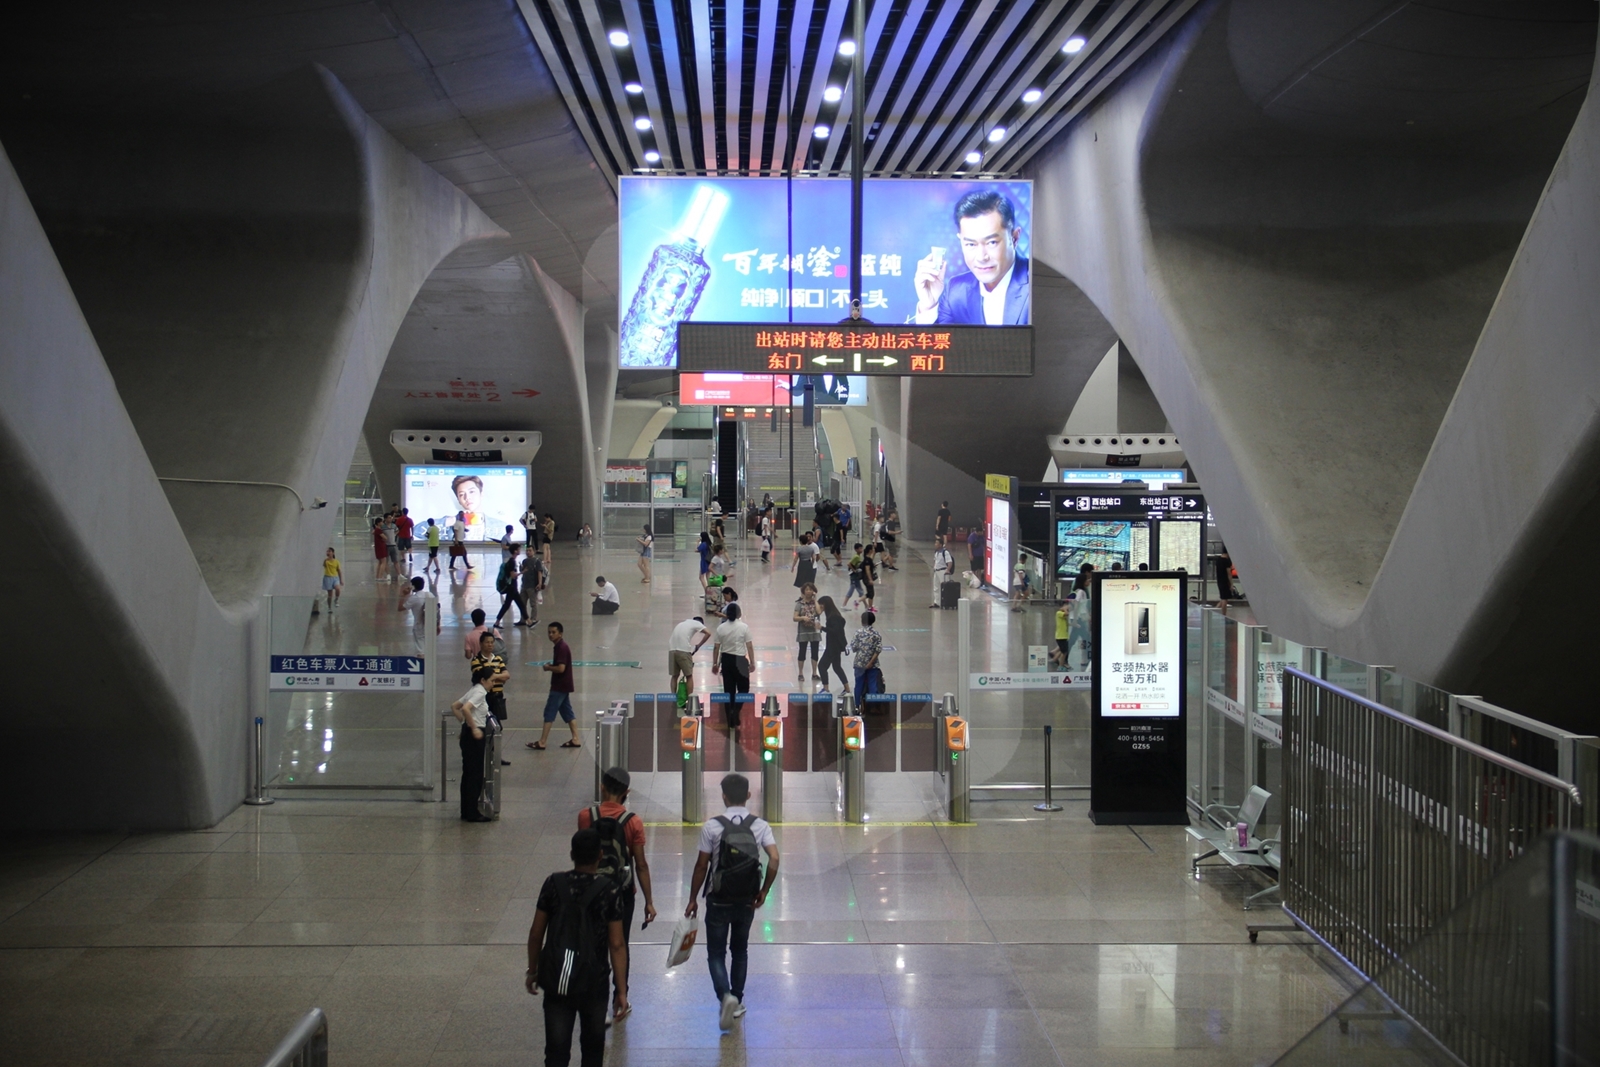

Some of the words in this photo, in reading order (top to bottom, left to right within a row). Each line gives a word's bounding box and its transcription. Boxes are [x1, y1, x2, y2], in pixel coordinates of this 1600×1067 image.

[740, 287, 778, 308] 纯净
[786, 288, 824, 308] 顺口
[755, 331, 951, 349] 出站时请您主动出示车票
[768, 353, 802, 370] 东门
[911, 354, 944, 371] 西门
[486, 392, 502, 402] 2
[1092, 497, 1121, 506] 西出站口
[1140, 497, 1168, 506] 东出站口
[281, 657, 393, 672] 红色车票人工通道
[1112, 662, 1169, 673] 变频热水器
[1123, 674, 1158, 684] 选万和
